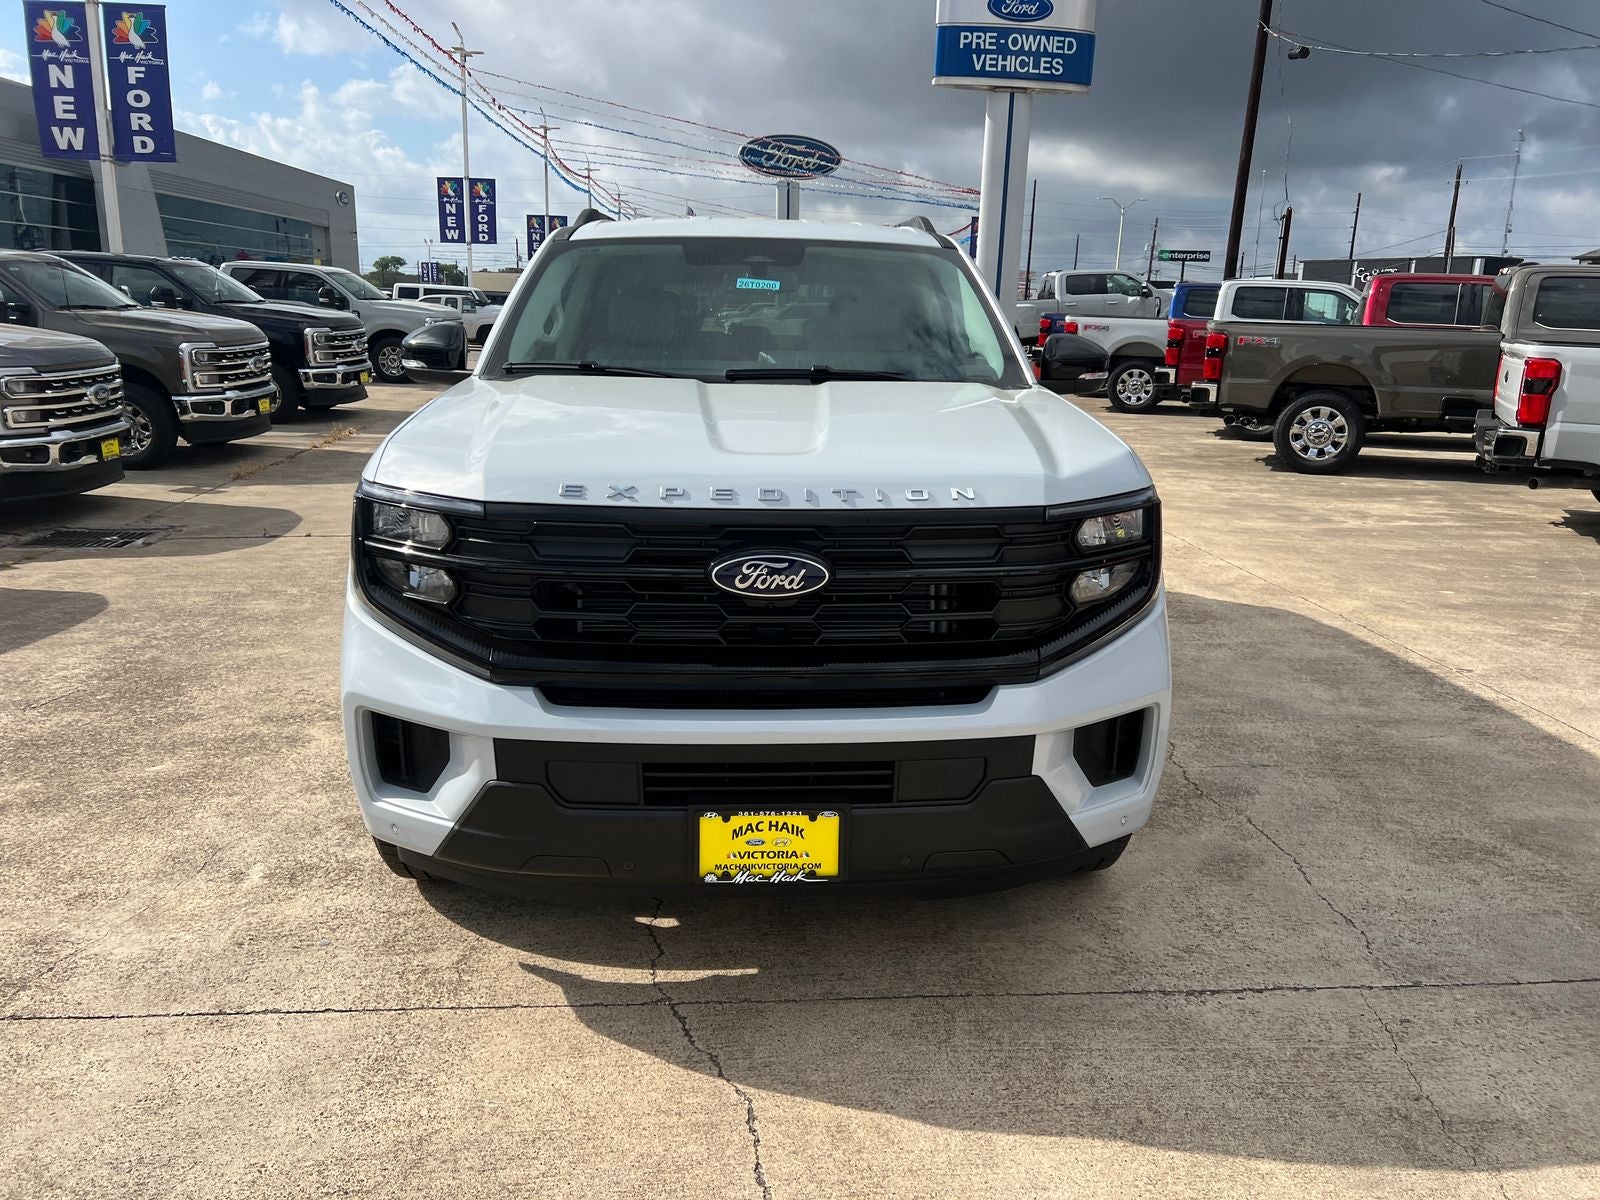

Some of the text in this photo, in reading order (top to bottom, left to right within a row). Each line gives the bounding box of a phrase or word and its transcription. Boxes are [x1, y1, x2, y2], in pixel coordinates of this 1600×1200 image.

[1002, 0, 1039, 14] Ford
[972, 54, 1064, 75] VEHICLES
[48, 64, 85, 151] NEW
[126, 66, 155, 154] FORD
[762, 142, 819, 170] Ford
[445, 203, 460, 240] NEW
[477, 204, 489, 242] FORD
[1161, 252, 1210, 260] enterprise
[738, 281, 777, 289] 26T0200
[1238, 335, 1278, 346] FX4
[558, 482, 976, 502] EXPEDITION
[734, 560, 807, 590] Ford
[731, 820, 805, 840] MAC HAIK
[737, 850, 799, 860] VICTORIA
[714, 862, 822, 872] MACHAIKVICTORIA.COM
[731, 868, 809, 884] Mac Haik
